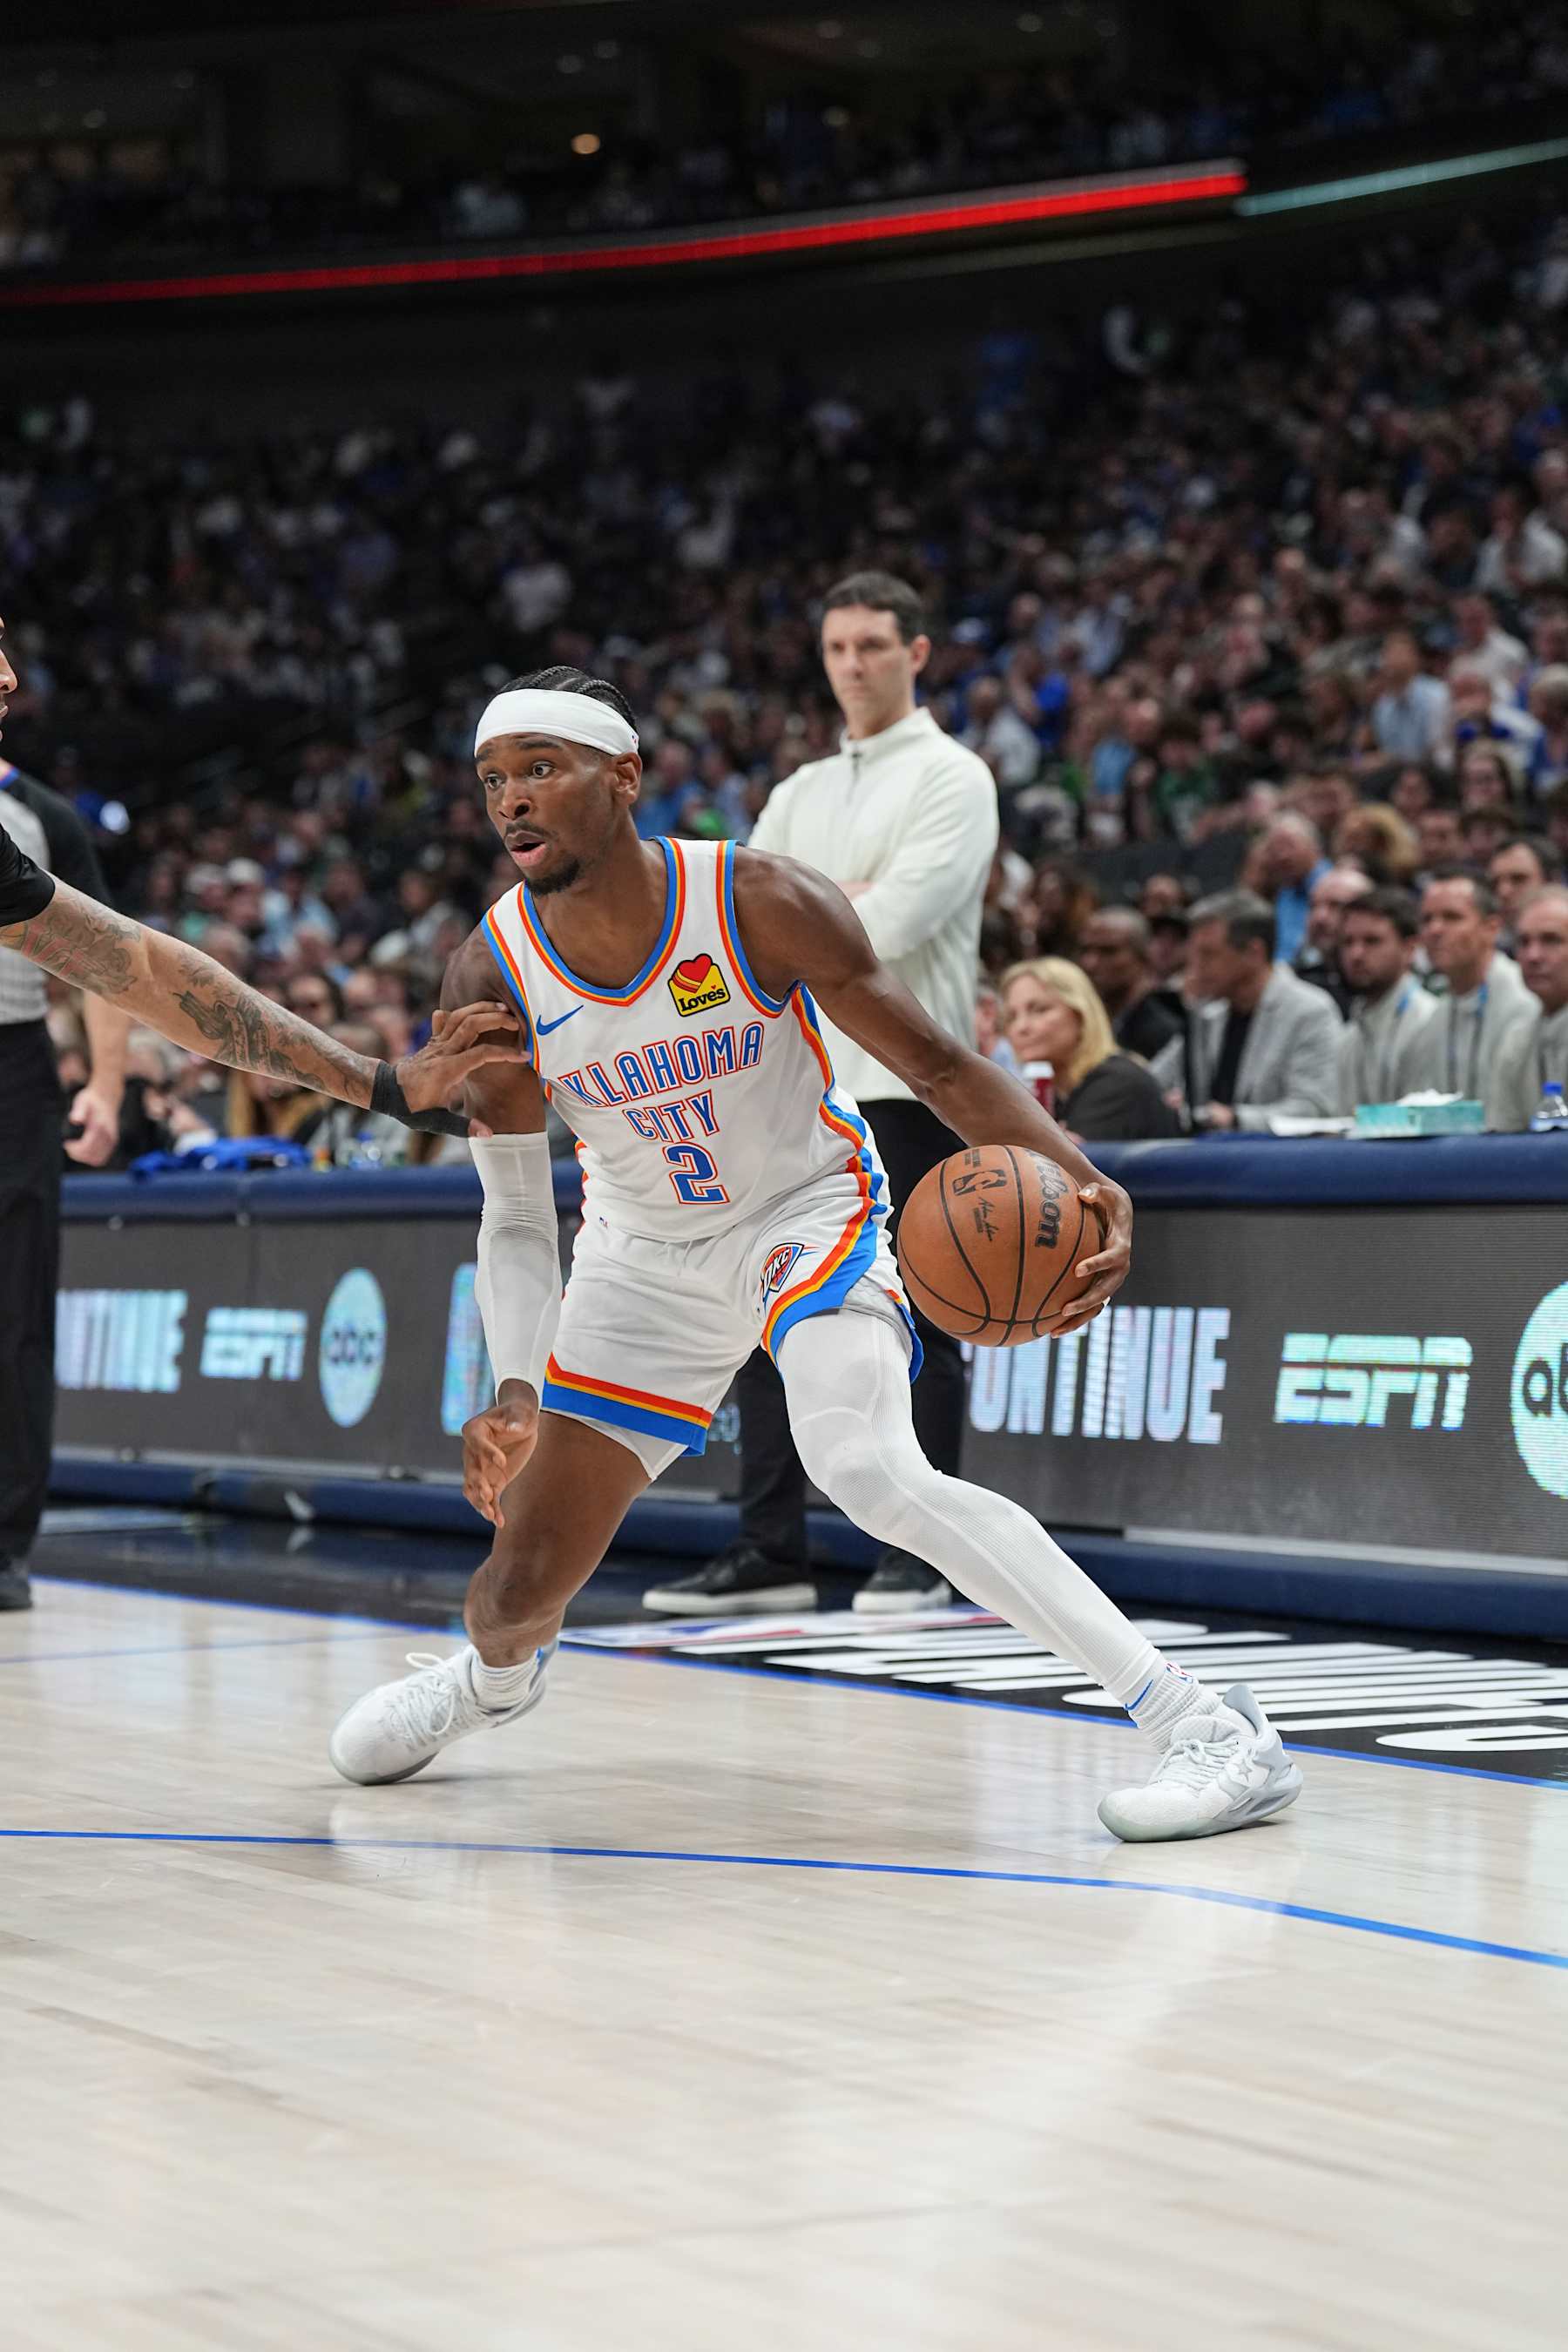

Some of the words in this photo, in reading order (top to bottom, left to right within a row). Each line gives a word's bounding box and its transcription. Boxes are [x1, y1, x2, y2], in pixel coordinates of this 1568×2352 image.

[558, 1021, 765, 1108] KLAHOMA
[622, 1089, 720, 1142] CITY
[662, 1141, 731, 1205] 2
[199, 1307, 308, 1381] ESPN
[959, 1306, 1230, 1443] ONTINUE
[1273, 1332, 1473, 1430] ESPN
